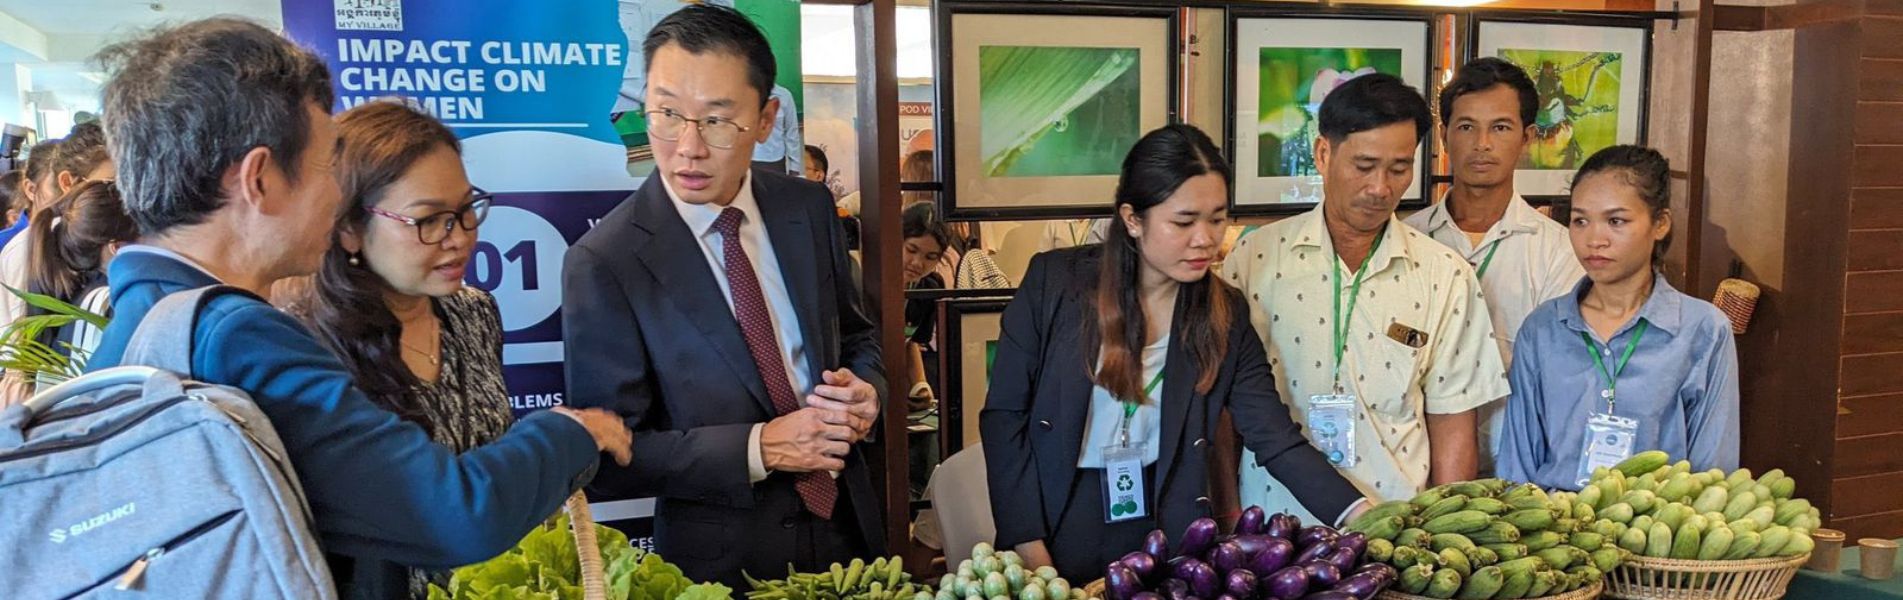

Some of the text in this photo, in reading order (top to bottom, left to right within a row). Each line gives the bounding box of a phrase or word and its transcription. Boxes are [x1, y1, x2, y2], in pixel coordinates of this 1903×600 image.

[356, 21, 400, 29] VILLAGE
[338, 38, 621, 66] IMPACT CLIMATE
[340, 67, 546, 92] CHANGE ON
[341, 96, 484, 119] MEN
[464, 240, 539, 292] 01
[69, 502, 135, 536] SUZUKI
